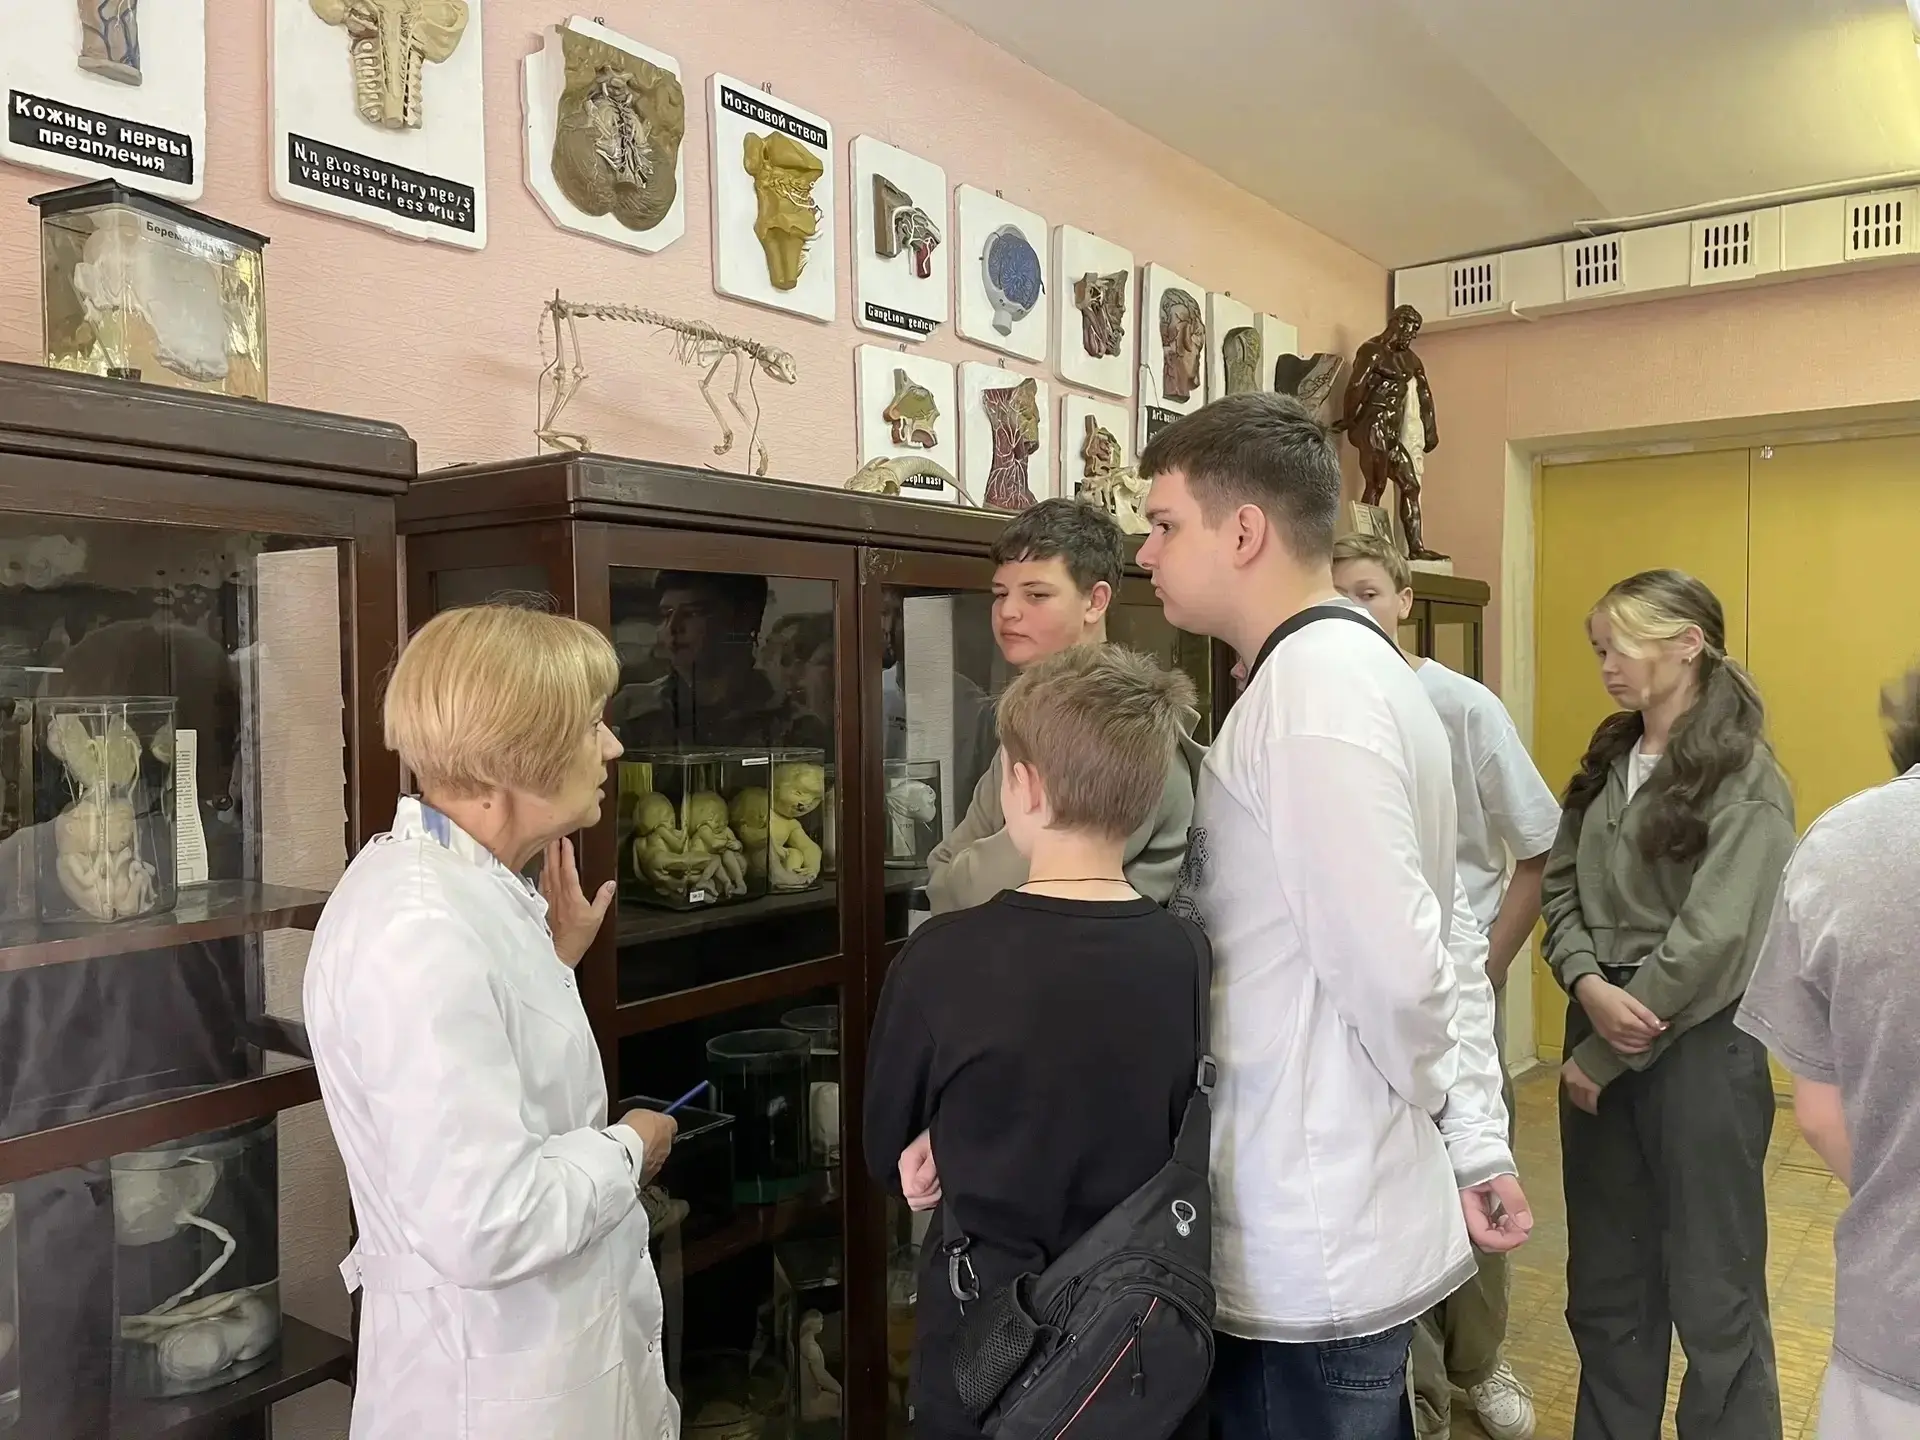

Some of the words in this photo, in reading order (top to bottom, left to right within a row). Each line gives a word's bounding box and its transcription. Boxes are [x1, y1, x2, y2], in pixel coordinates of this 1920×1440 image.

[15, 95, 107, 136] Кожные
[120, 127, 187, 157] нервы
[724, 90, 786, 129] Мозговой
[788, 121, 824, 145] ствол
[39, 128, 165, 172] предплечия
[301, 165, 350, 190] vagus
